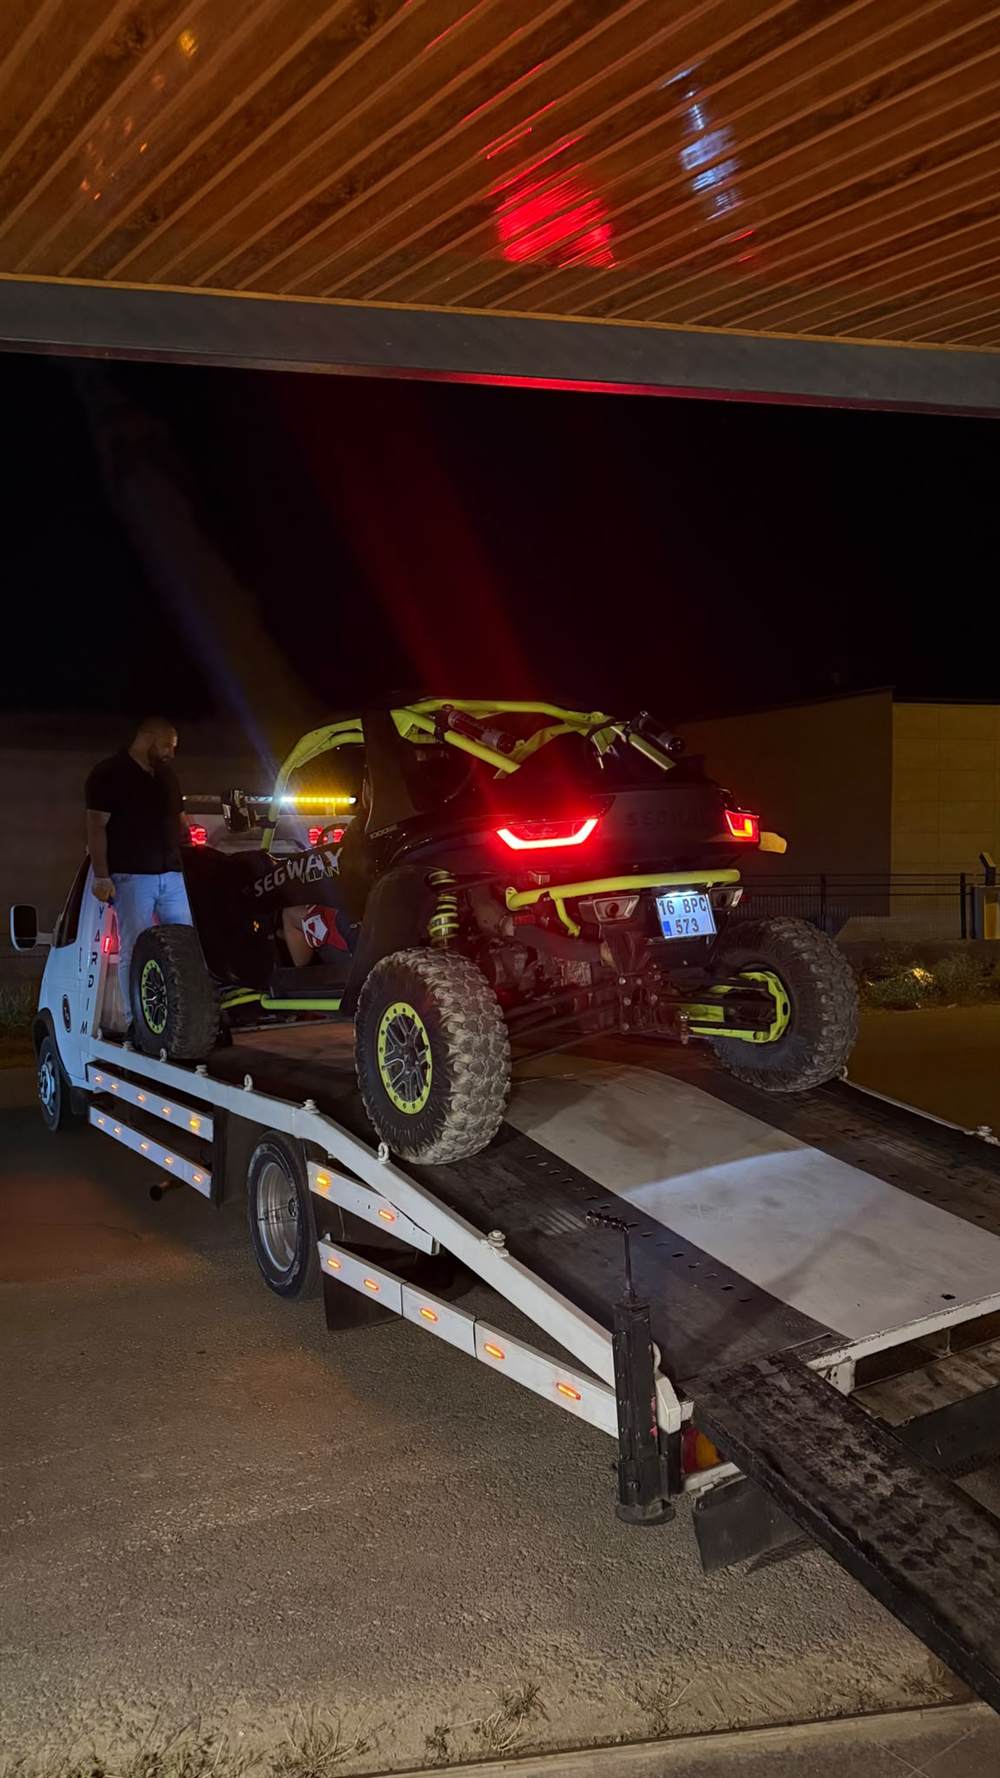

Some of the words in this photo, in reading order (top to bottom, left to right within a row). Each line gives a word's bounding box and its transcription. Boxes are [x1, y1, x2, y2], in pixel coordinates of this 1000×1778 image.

[254, 847, 343, 897] SEGWAY
[659, 899, 675, 916] 16
[682, 896, 707, 913] BPC
[675, 917, 699, 934] 573
